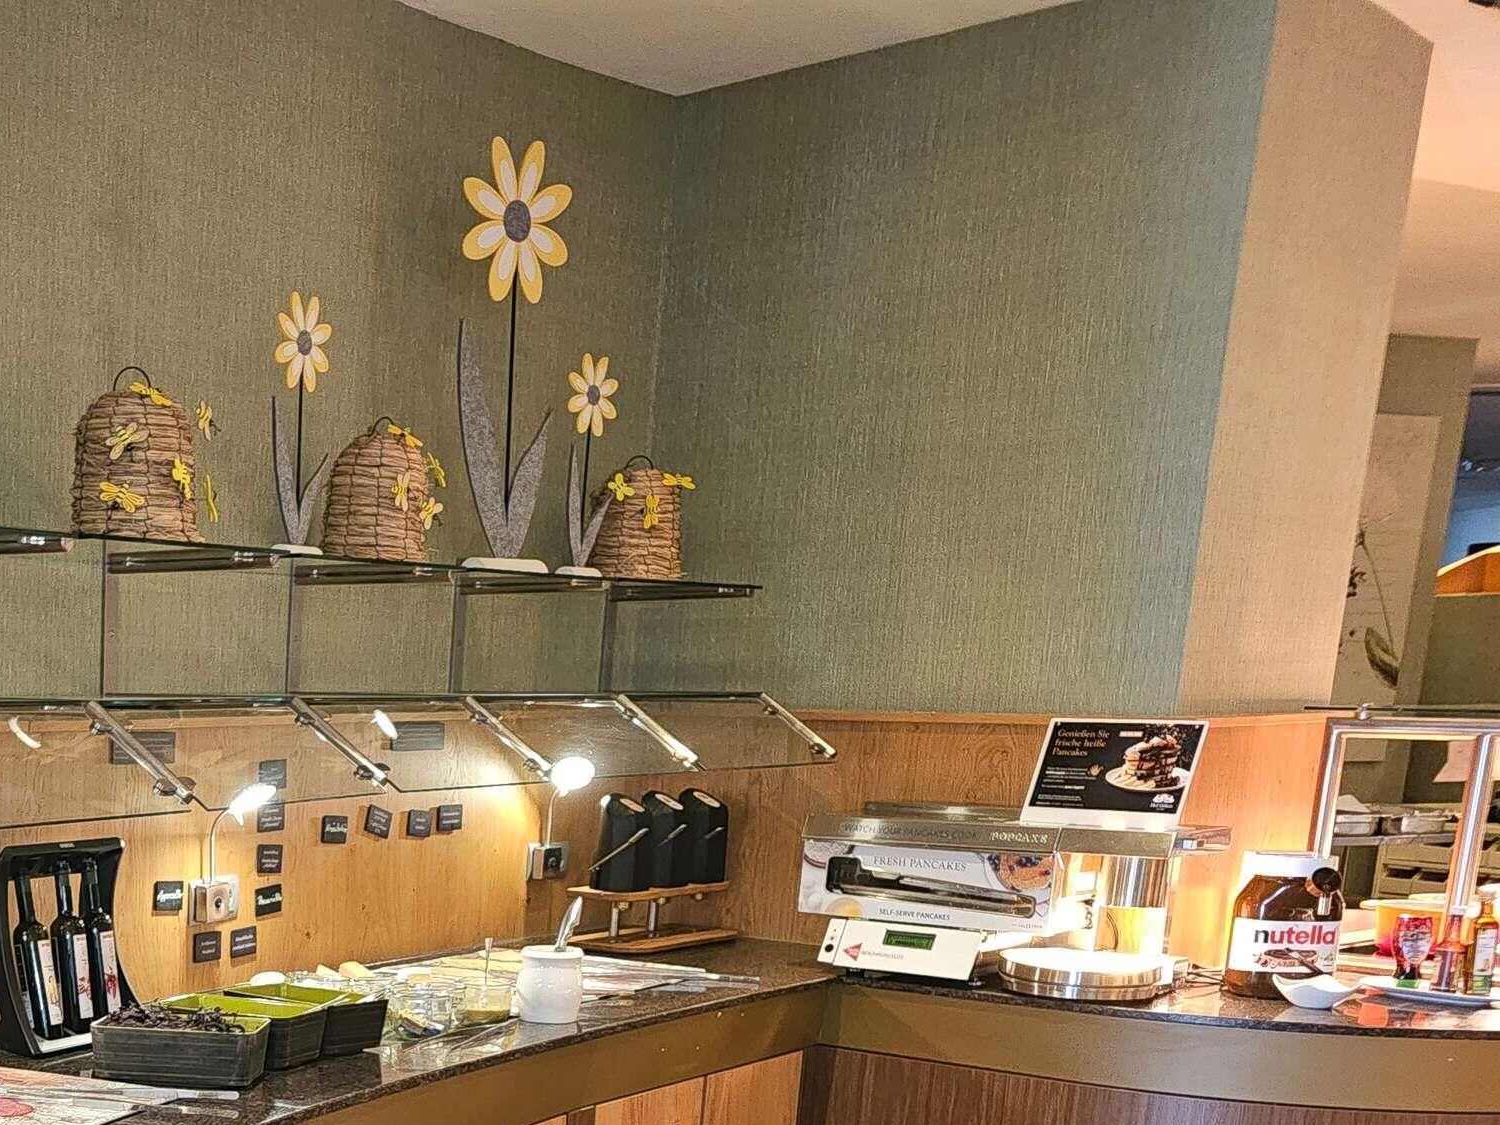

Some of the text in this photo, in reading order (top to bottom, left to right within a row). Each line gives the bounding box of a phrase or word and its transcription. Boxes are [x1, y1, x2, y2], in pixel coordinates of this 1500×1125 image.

[1098, 730, 1110, 738] Sie
[1052, 747, 1088, 756] Pancakes
[873, 855, 967, 872] FRESH PANCAKES
[879, 908, 951, 921] SELF-SERVE PANCAKES
[1253, 924, 1337, 945] nutella
